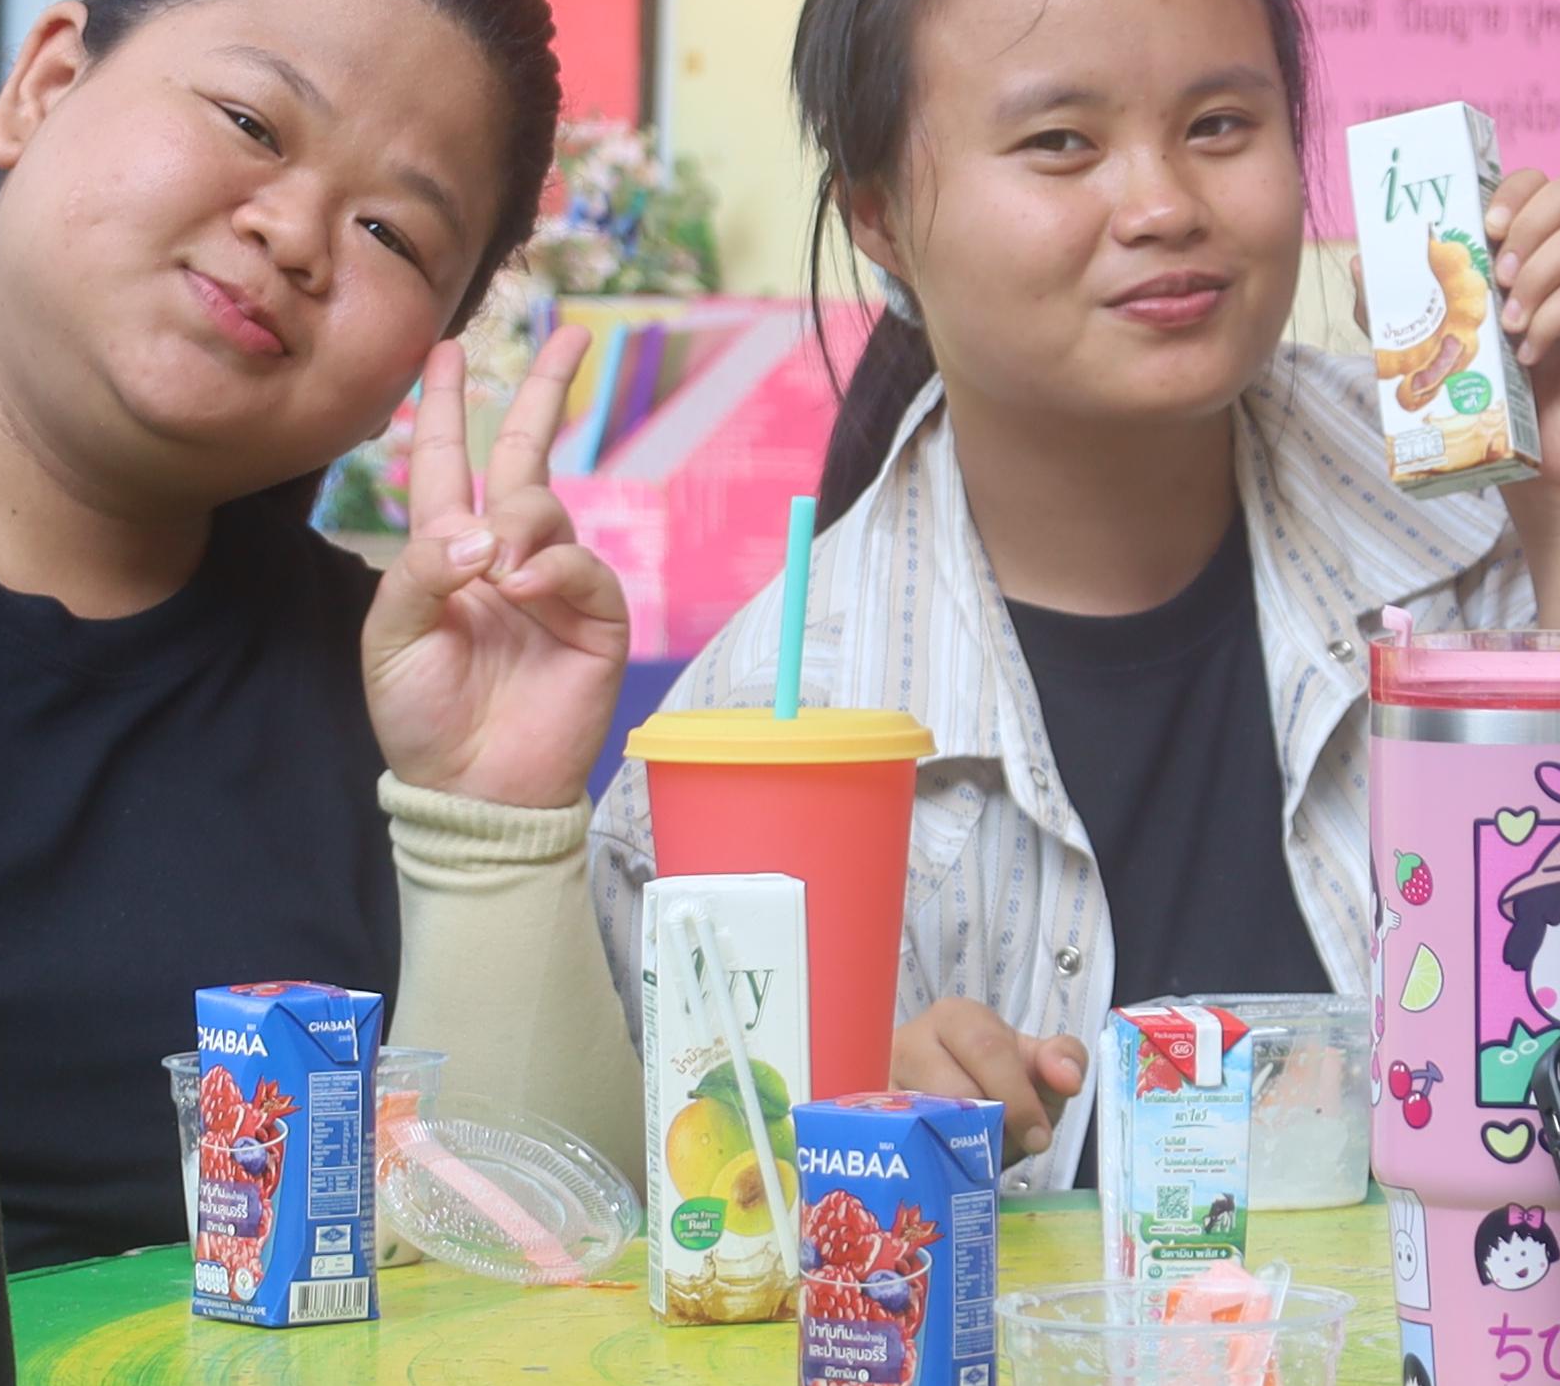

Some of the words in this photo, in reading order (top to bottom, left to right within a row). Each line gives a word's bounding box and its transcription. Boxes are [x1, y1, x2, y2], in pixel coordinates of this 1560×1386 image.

[1380, 147, 1455, 227] ivy
[1173, 1044, 1190, 1055] SIG
[797, 1147, 910, 1180] CHABAA
[688, 1219, 711, 1230] Real
